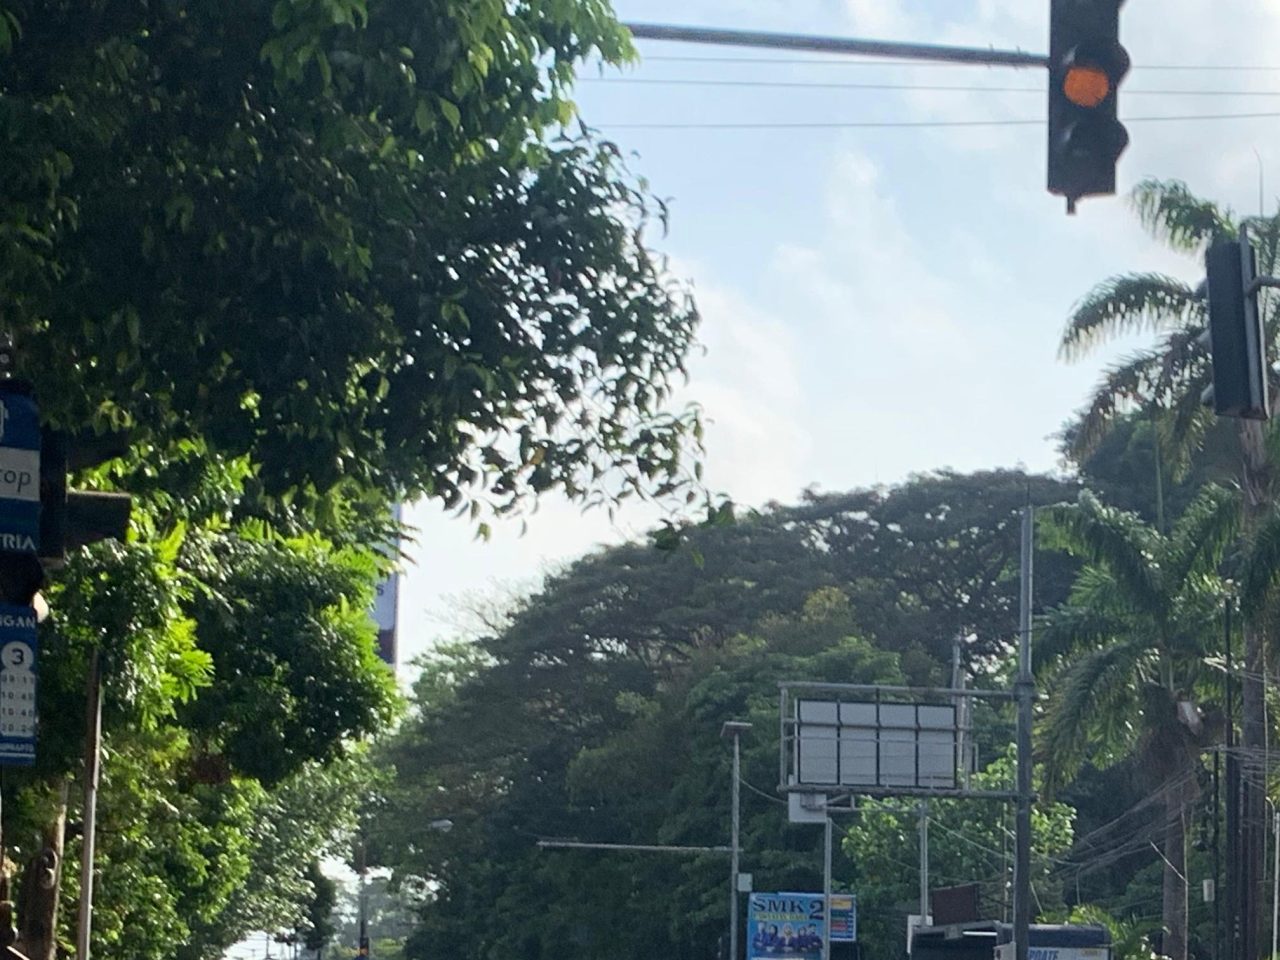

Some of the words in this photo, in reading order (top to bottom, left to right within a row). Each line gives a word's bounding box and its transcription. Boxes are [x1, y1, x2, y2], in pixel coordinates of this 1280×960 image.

[11, 648, 25, 665] 3
[752, 897, 805, 913] SMK
[809, 899, 824, 920] 2
